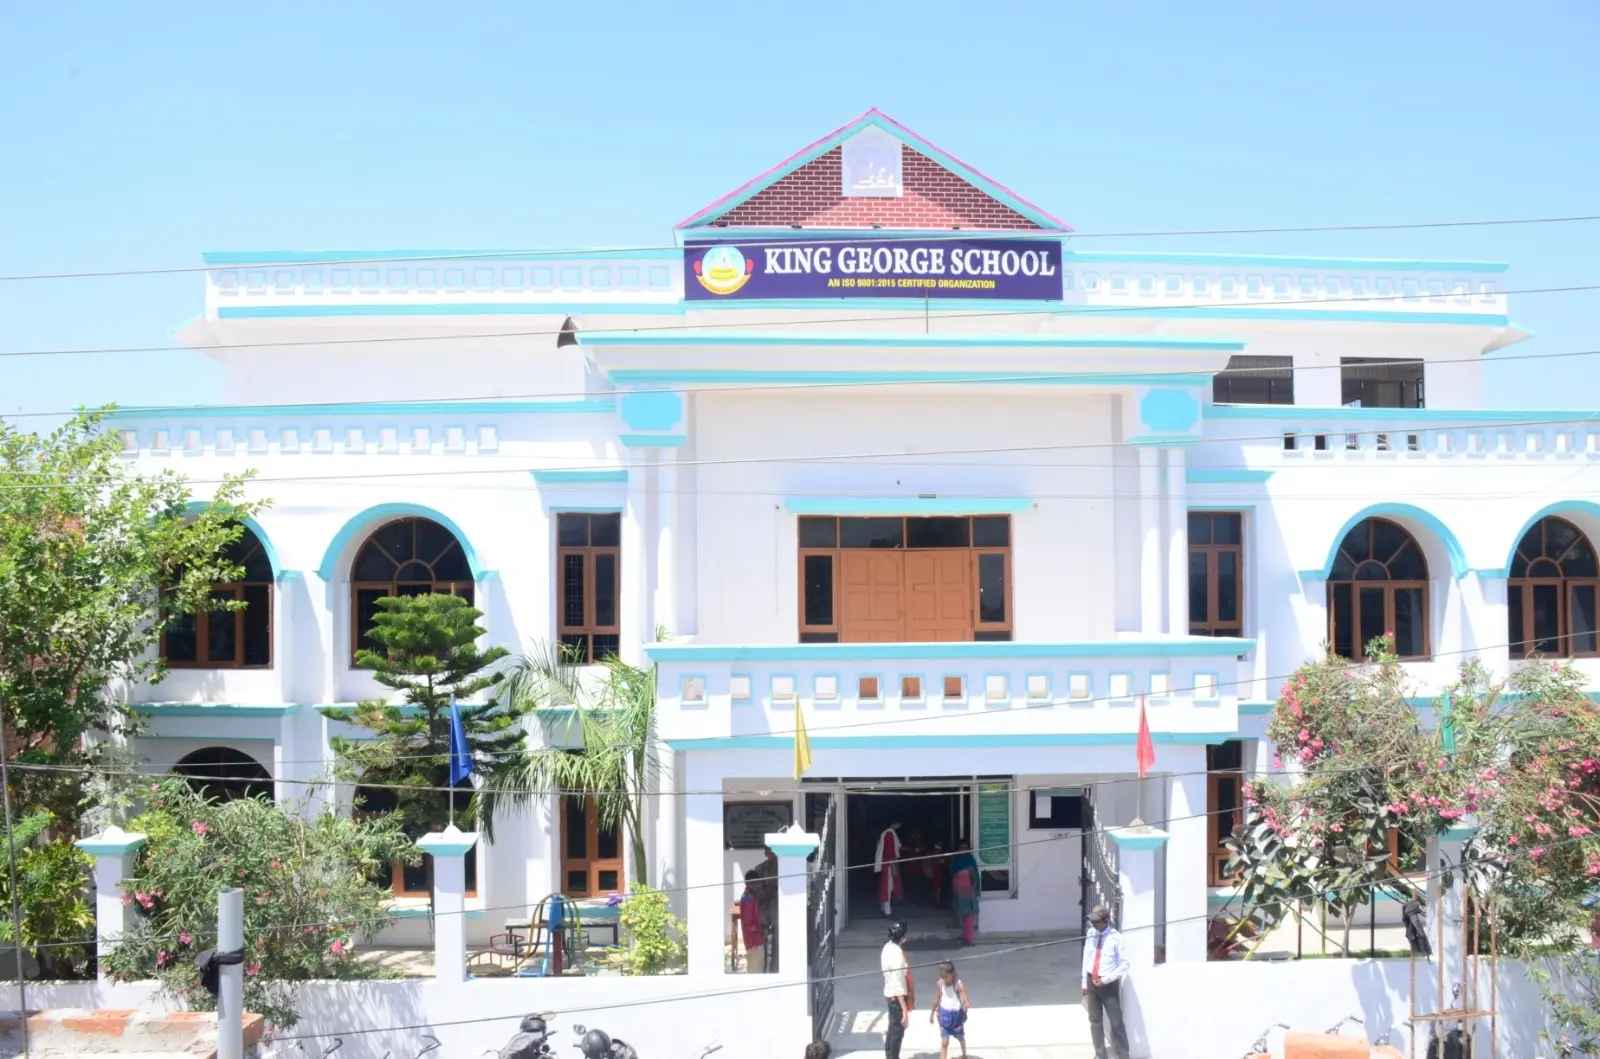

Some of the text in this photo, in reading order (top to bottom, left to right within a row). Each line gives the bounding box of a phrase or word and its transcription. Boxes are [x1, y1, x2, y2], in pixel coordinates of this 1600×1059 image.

[764, 247, 1055, 276] KING GEORGE SCHOOL
[827, 278, 996, 289] AN ISO 9001:2015 CERTIFIED ORGANIZATION
